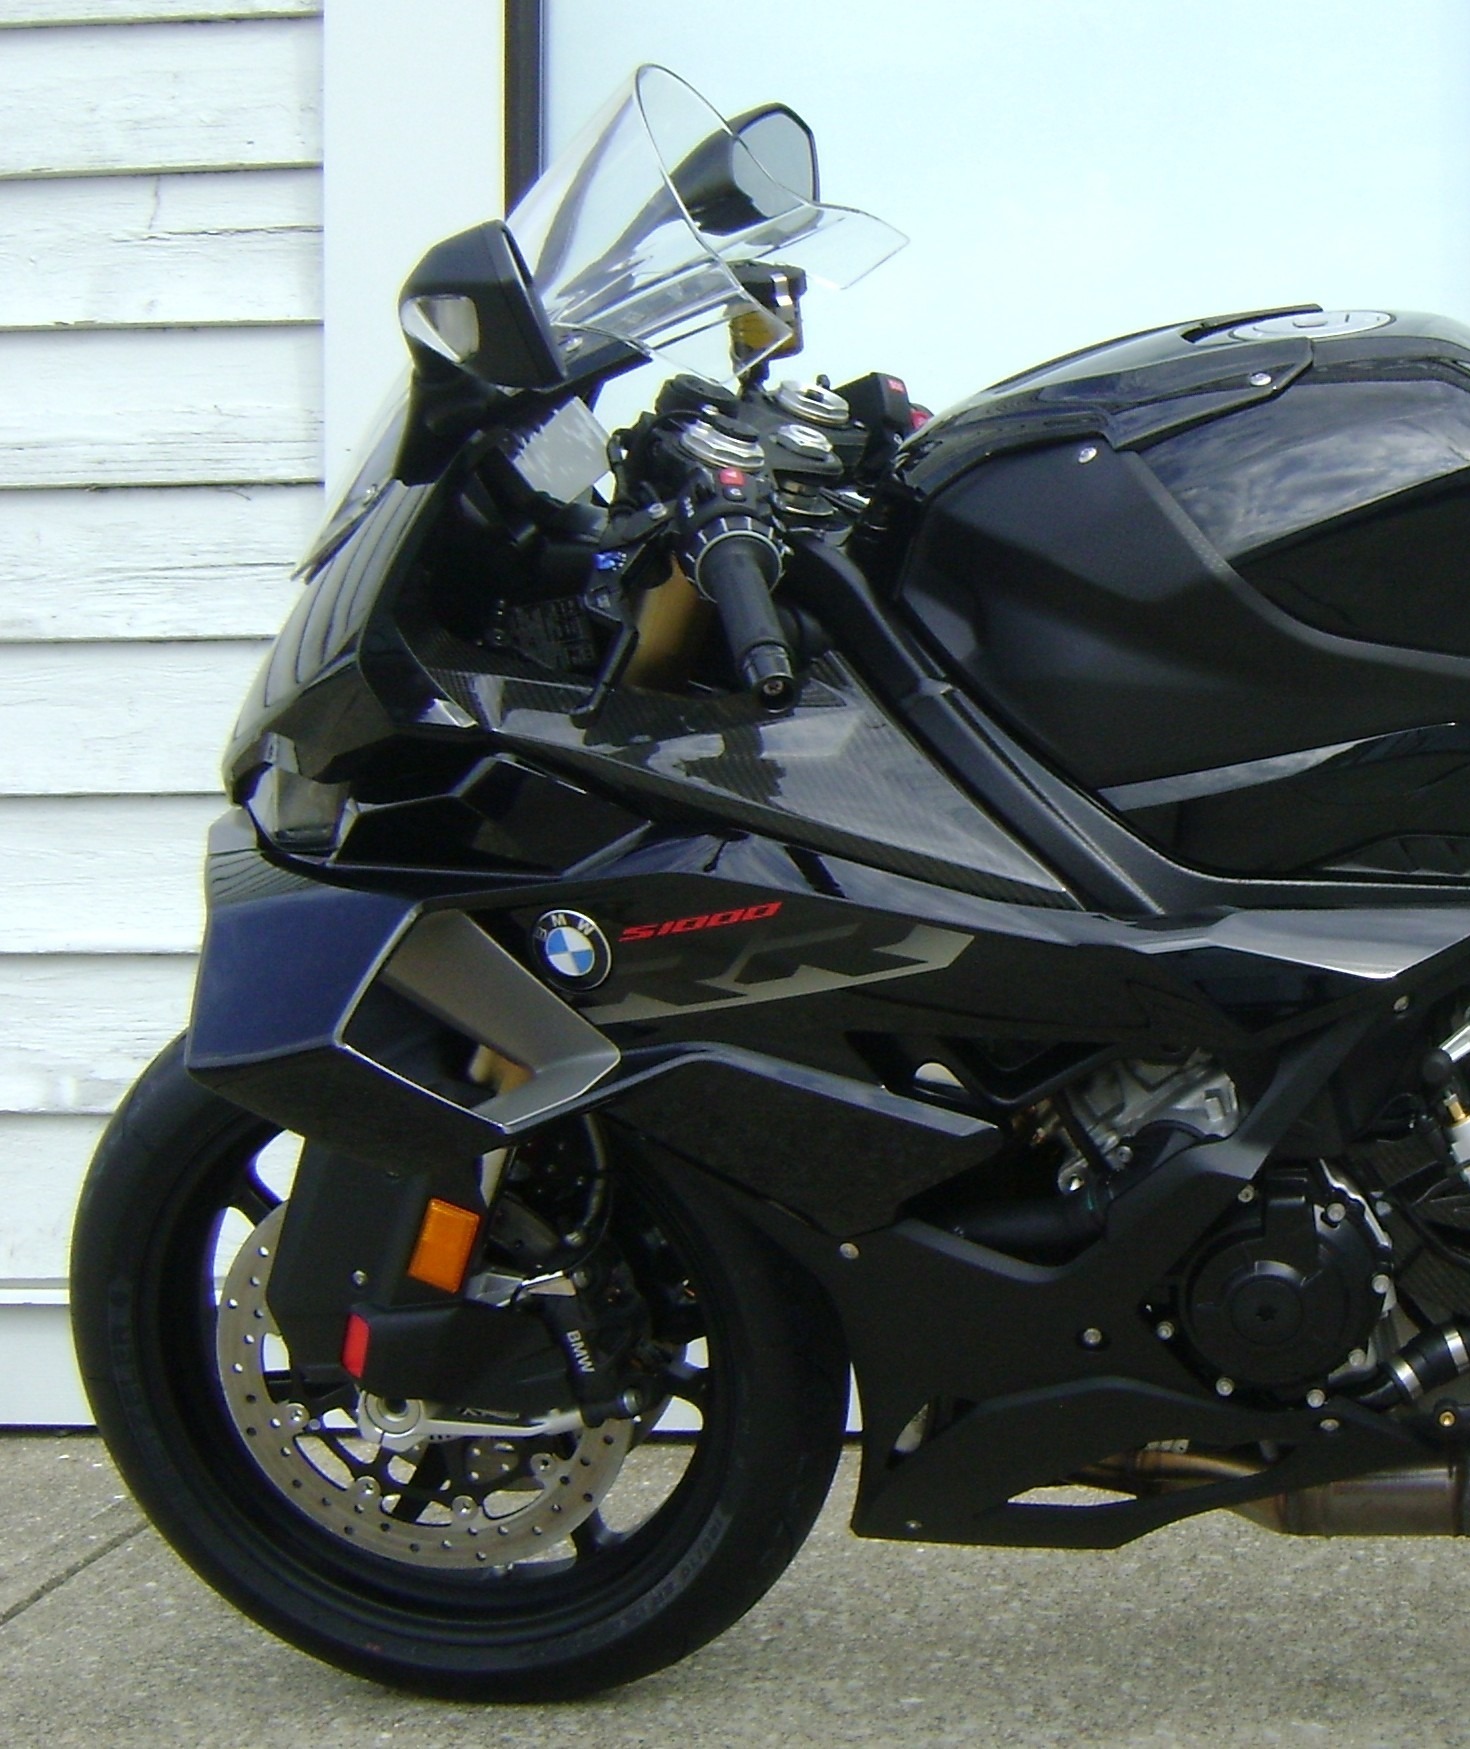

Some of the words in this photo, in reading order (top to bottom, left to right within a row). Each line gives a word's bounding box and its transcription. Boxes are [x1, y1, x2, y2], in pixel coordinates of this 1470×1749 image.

[533, 912, 597, 943] BMW
[619, 901, 783, 942] S1000
[566, 1329, 596, 1373] BMW
